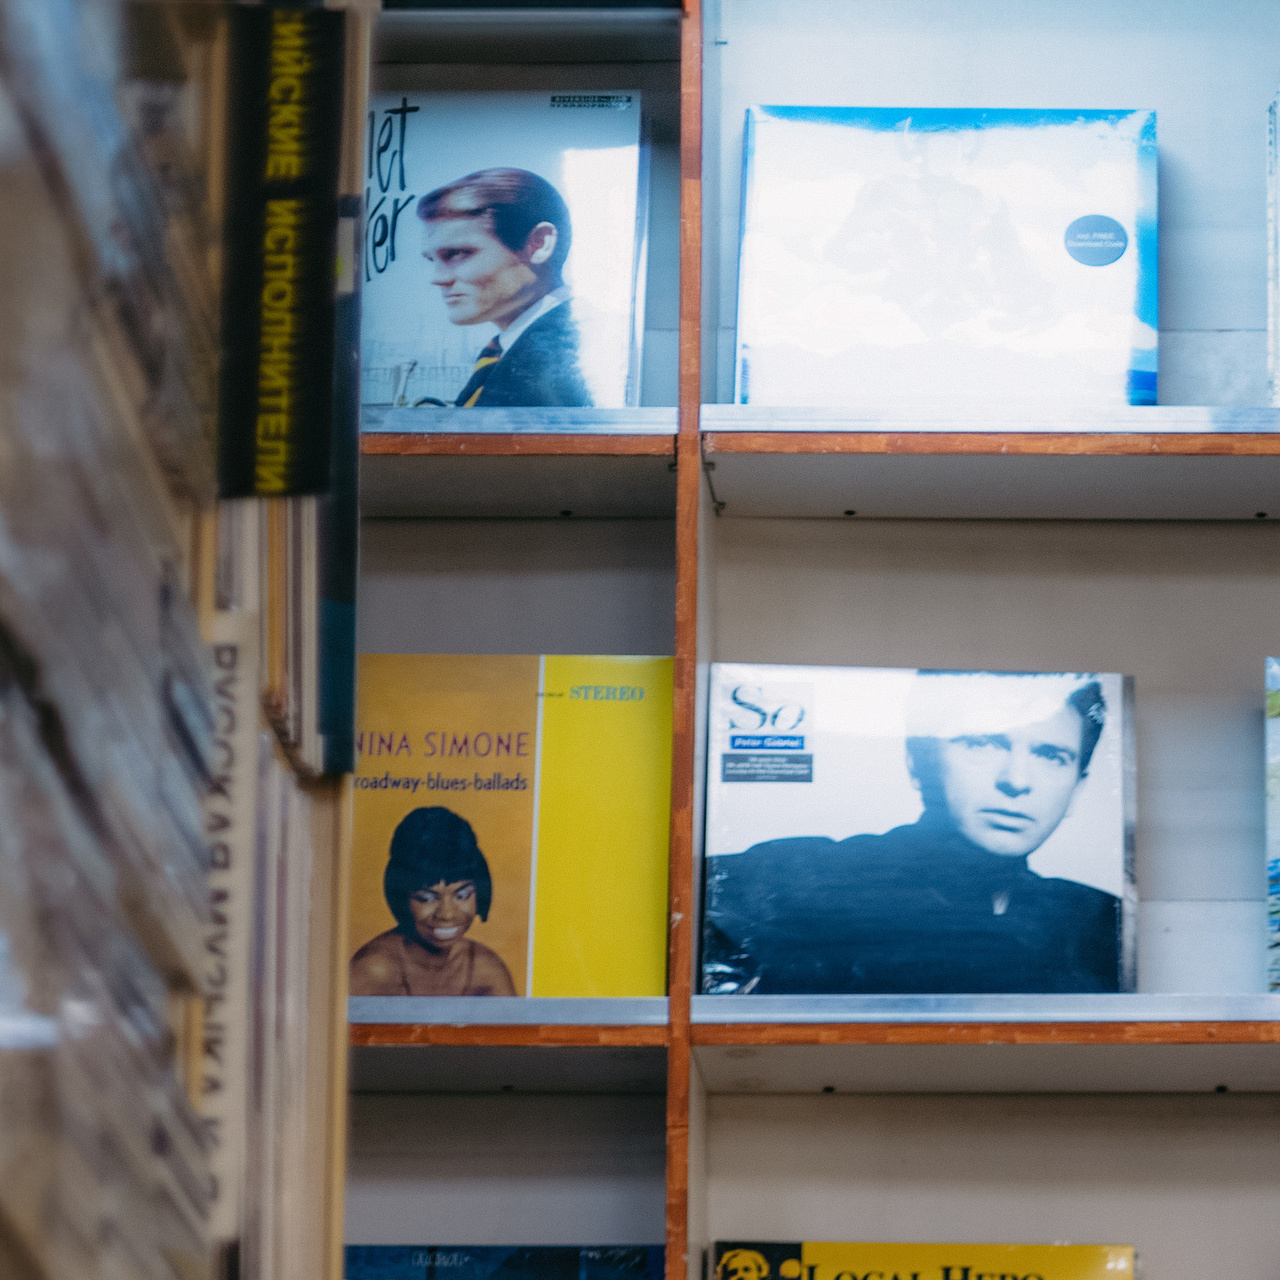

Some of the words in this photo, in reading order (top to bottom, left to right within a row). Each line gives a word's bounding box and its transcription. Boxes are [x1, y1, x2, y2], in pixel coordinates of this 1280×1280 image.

[255, 199, 300, 493] ИСПОЛНИТЕЛИ
[569, 685, 645, 702] STEREO
[729, 686, 805, 731] So
[424, 731, 530, 758] SIMONE
[352, 771, 528, 793] roadway-blues-ballads
